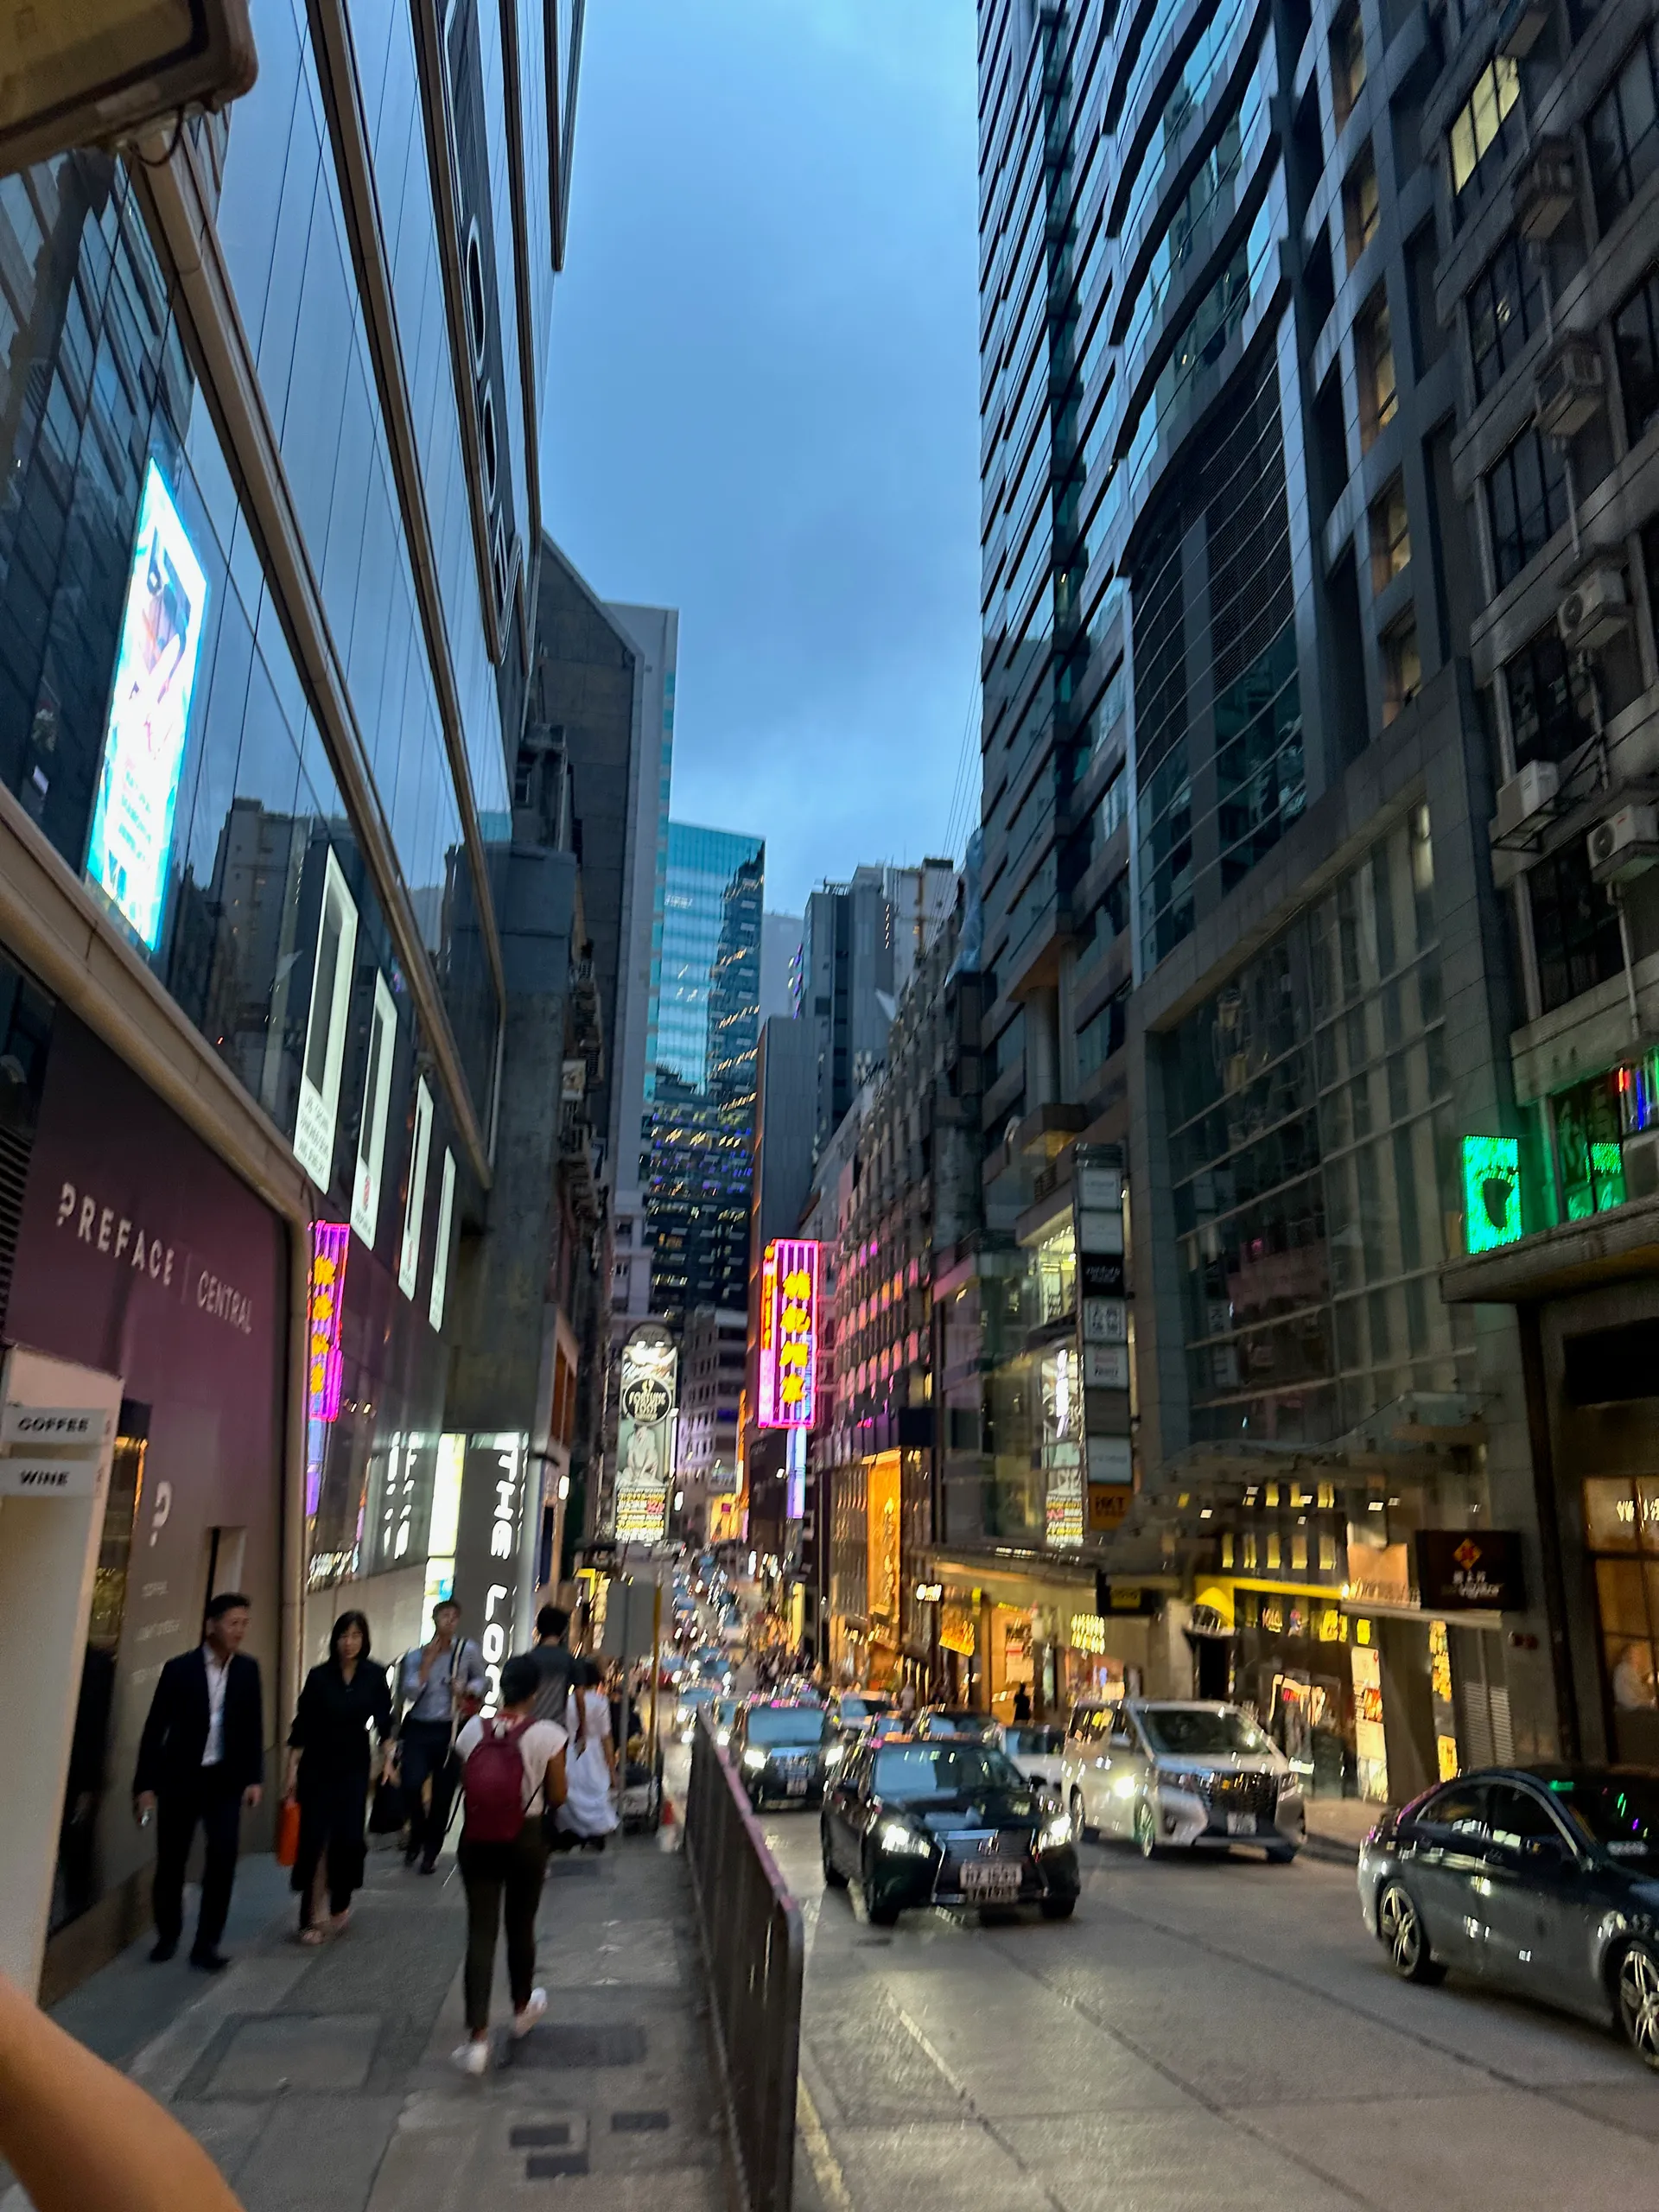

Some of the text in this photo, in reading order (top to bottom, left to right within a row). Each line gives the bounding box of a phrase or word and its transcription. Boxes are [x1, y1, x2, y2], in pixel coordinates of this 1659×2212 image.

[56, 1181, 175, 1287] PREFACE
[197, 1269, 252, 1335] CENTRAL
[18, 1416, 89, 1433] COFFEE
[21, 1471, 70, 1486] WINE
[491, 1447, 518, 1560] THE
